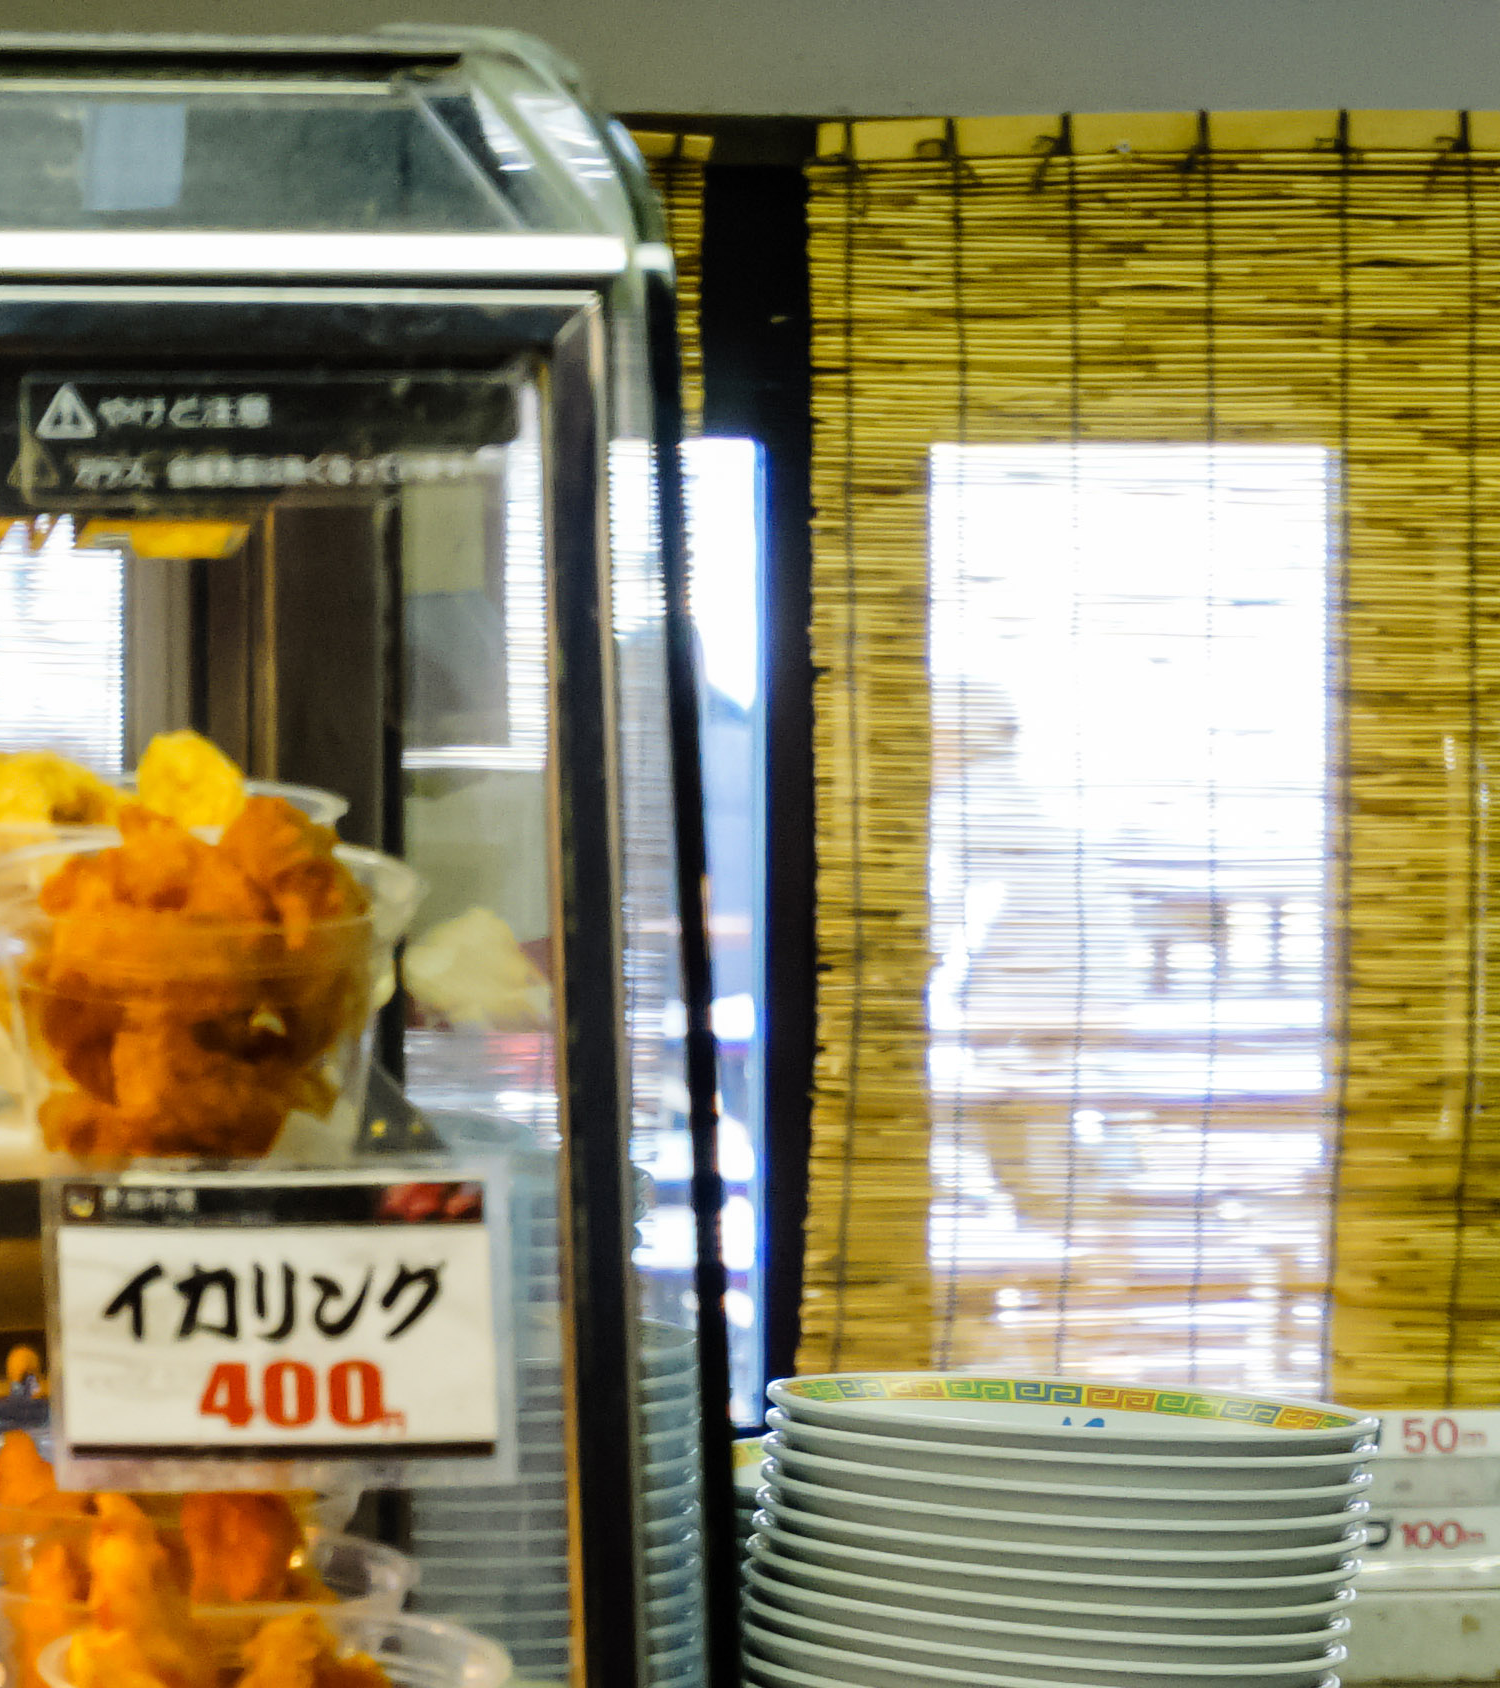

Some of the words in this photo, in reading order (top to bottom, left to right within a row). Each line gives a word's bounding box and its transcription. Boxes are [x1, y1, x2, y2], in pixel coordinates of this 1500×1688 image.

[104, 1262, 446, 1342] イカリング
[1402, 1416, 1486, 1454] 50m
